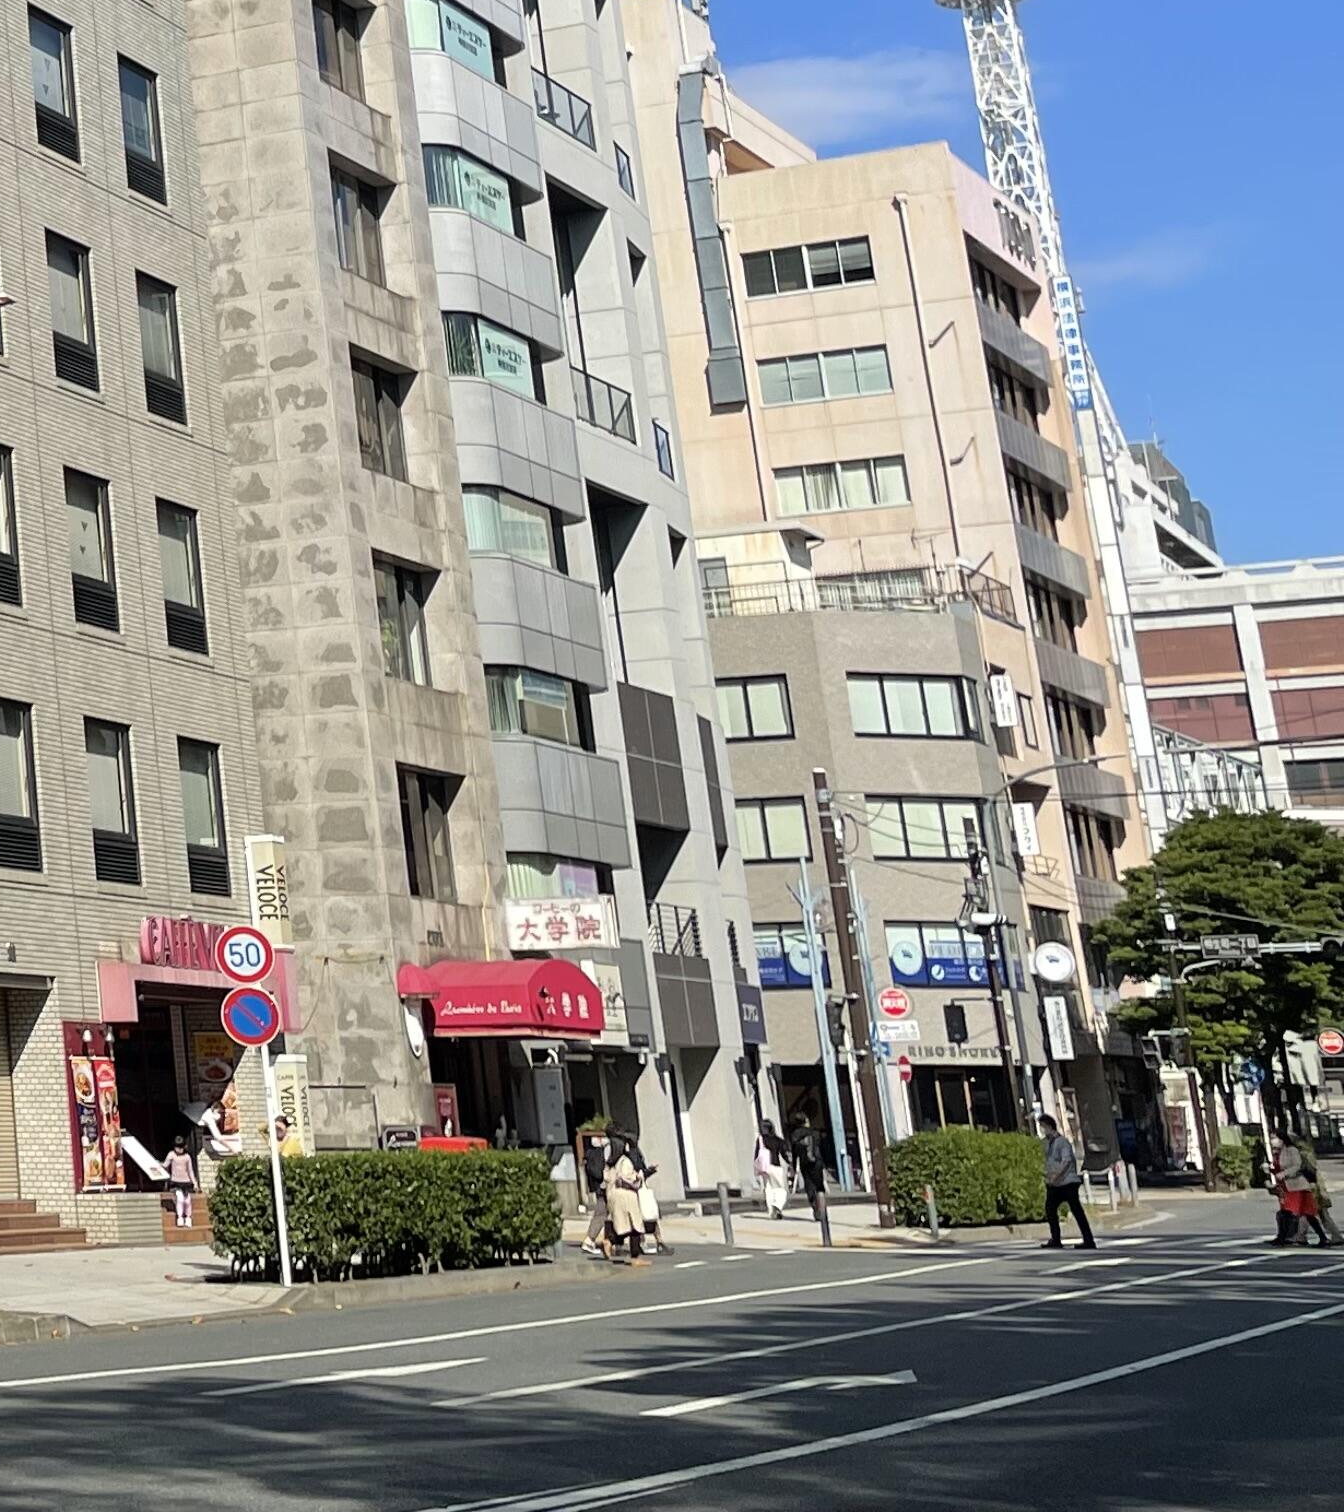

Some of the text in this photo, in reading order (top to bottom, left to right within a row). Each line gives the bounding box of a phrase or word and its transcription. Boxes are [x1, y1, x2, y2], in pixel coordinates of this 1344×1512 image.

[1056, 281, 1085, 385] 横浜法律事務所
[255, 864, 280, 921] VELOCE
[276, 865, 291, 922] VELOCE
[532, 903, 581, 915] コーヒーの
[516, 914, 602, 942] 大学院
[229, 943, 261, 968] 50
